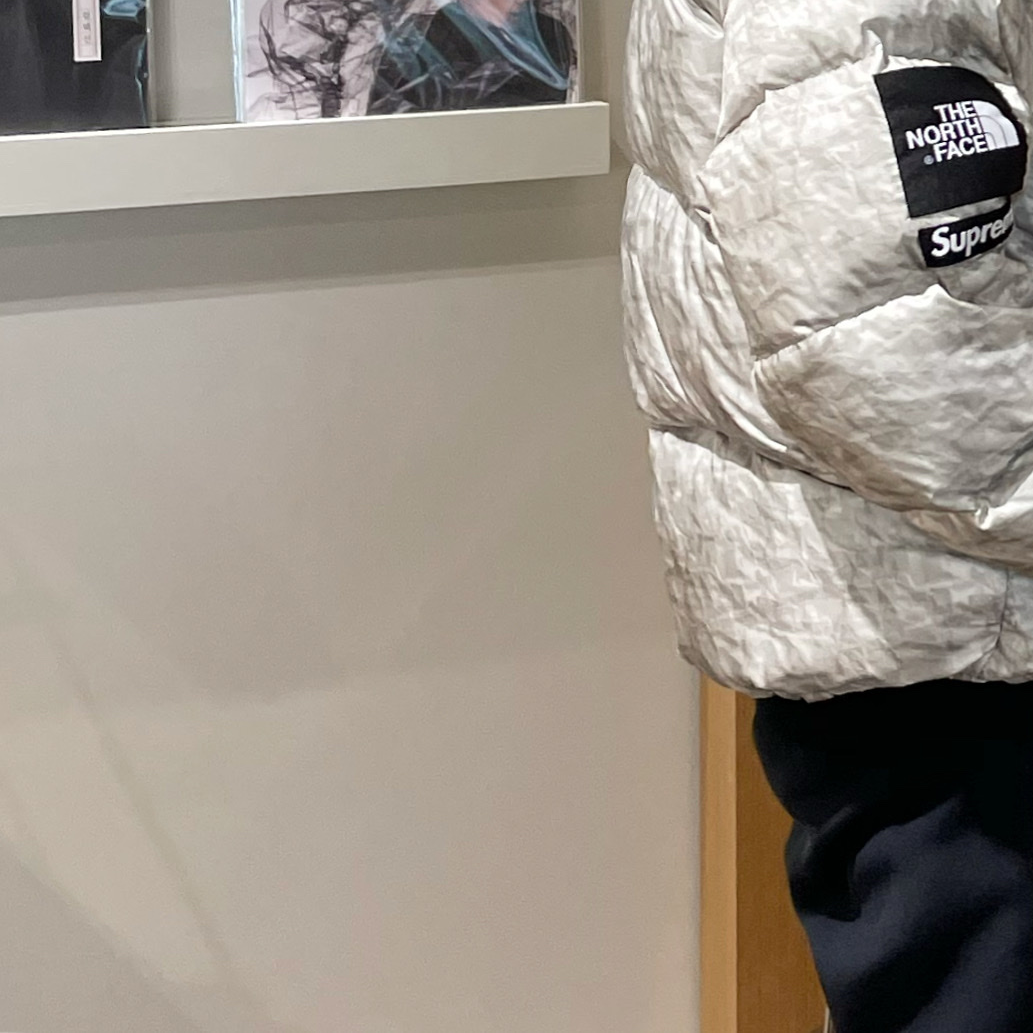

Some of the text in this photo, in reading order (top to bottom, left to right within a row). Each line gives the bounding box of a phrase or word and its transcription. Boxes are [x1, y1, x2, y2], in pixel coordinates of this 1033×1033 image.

[933, 100, 978, 123] THE
[905, 116, 983, 150] NORTH
[932, 133, 989, 163] FACE
